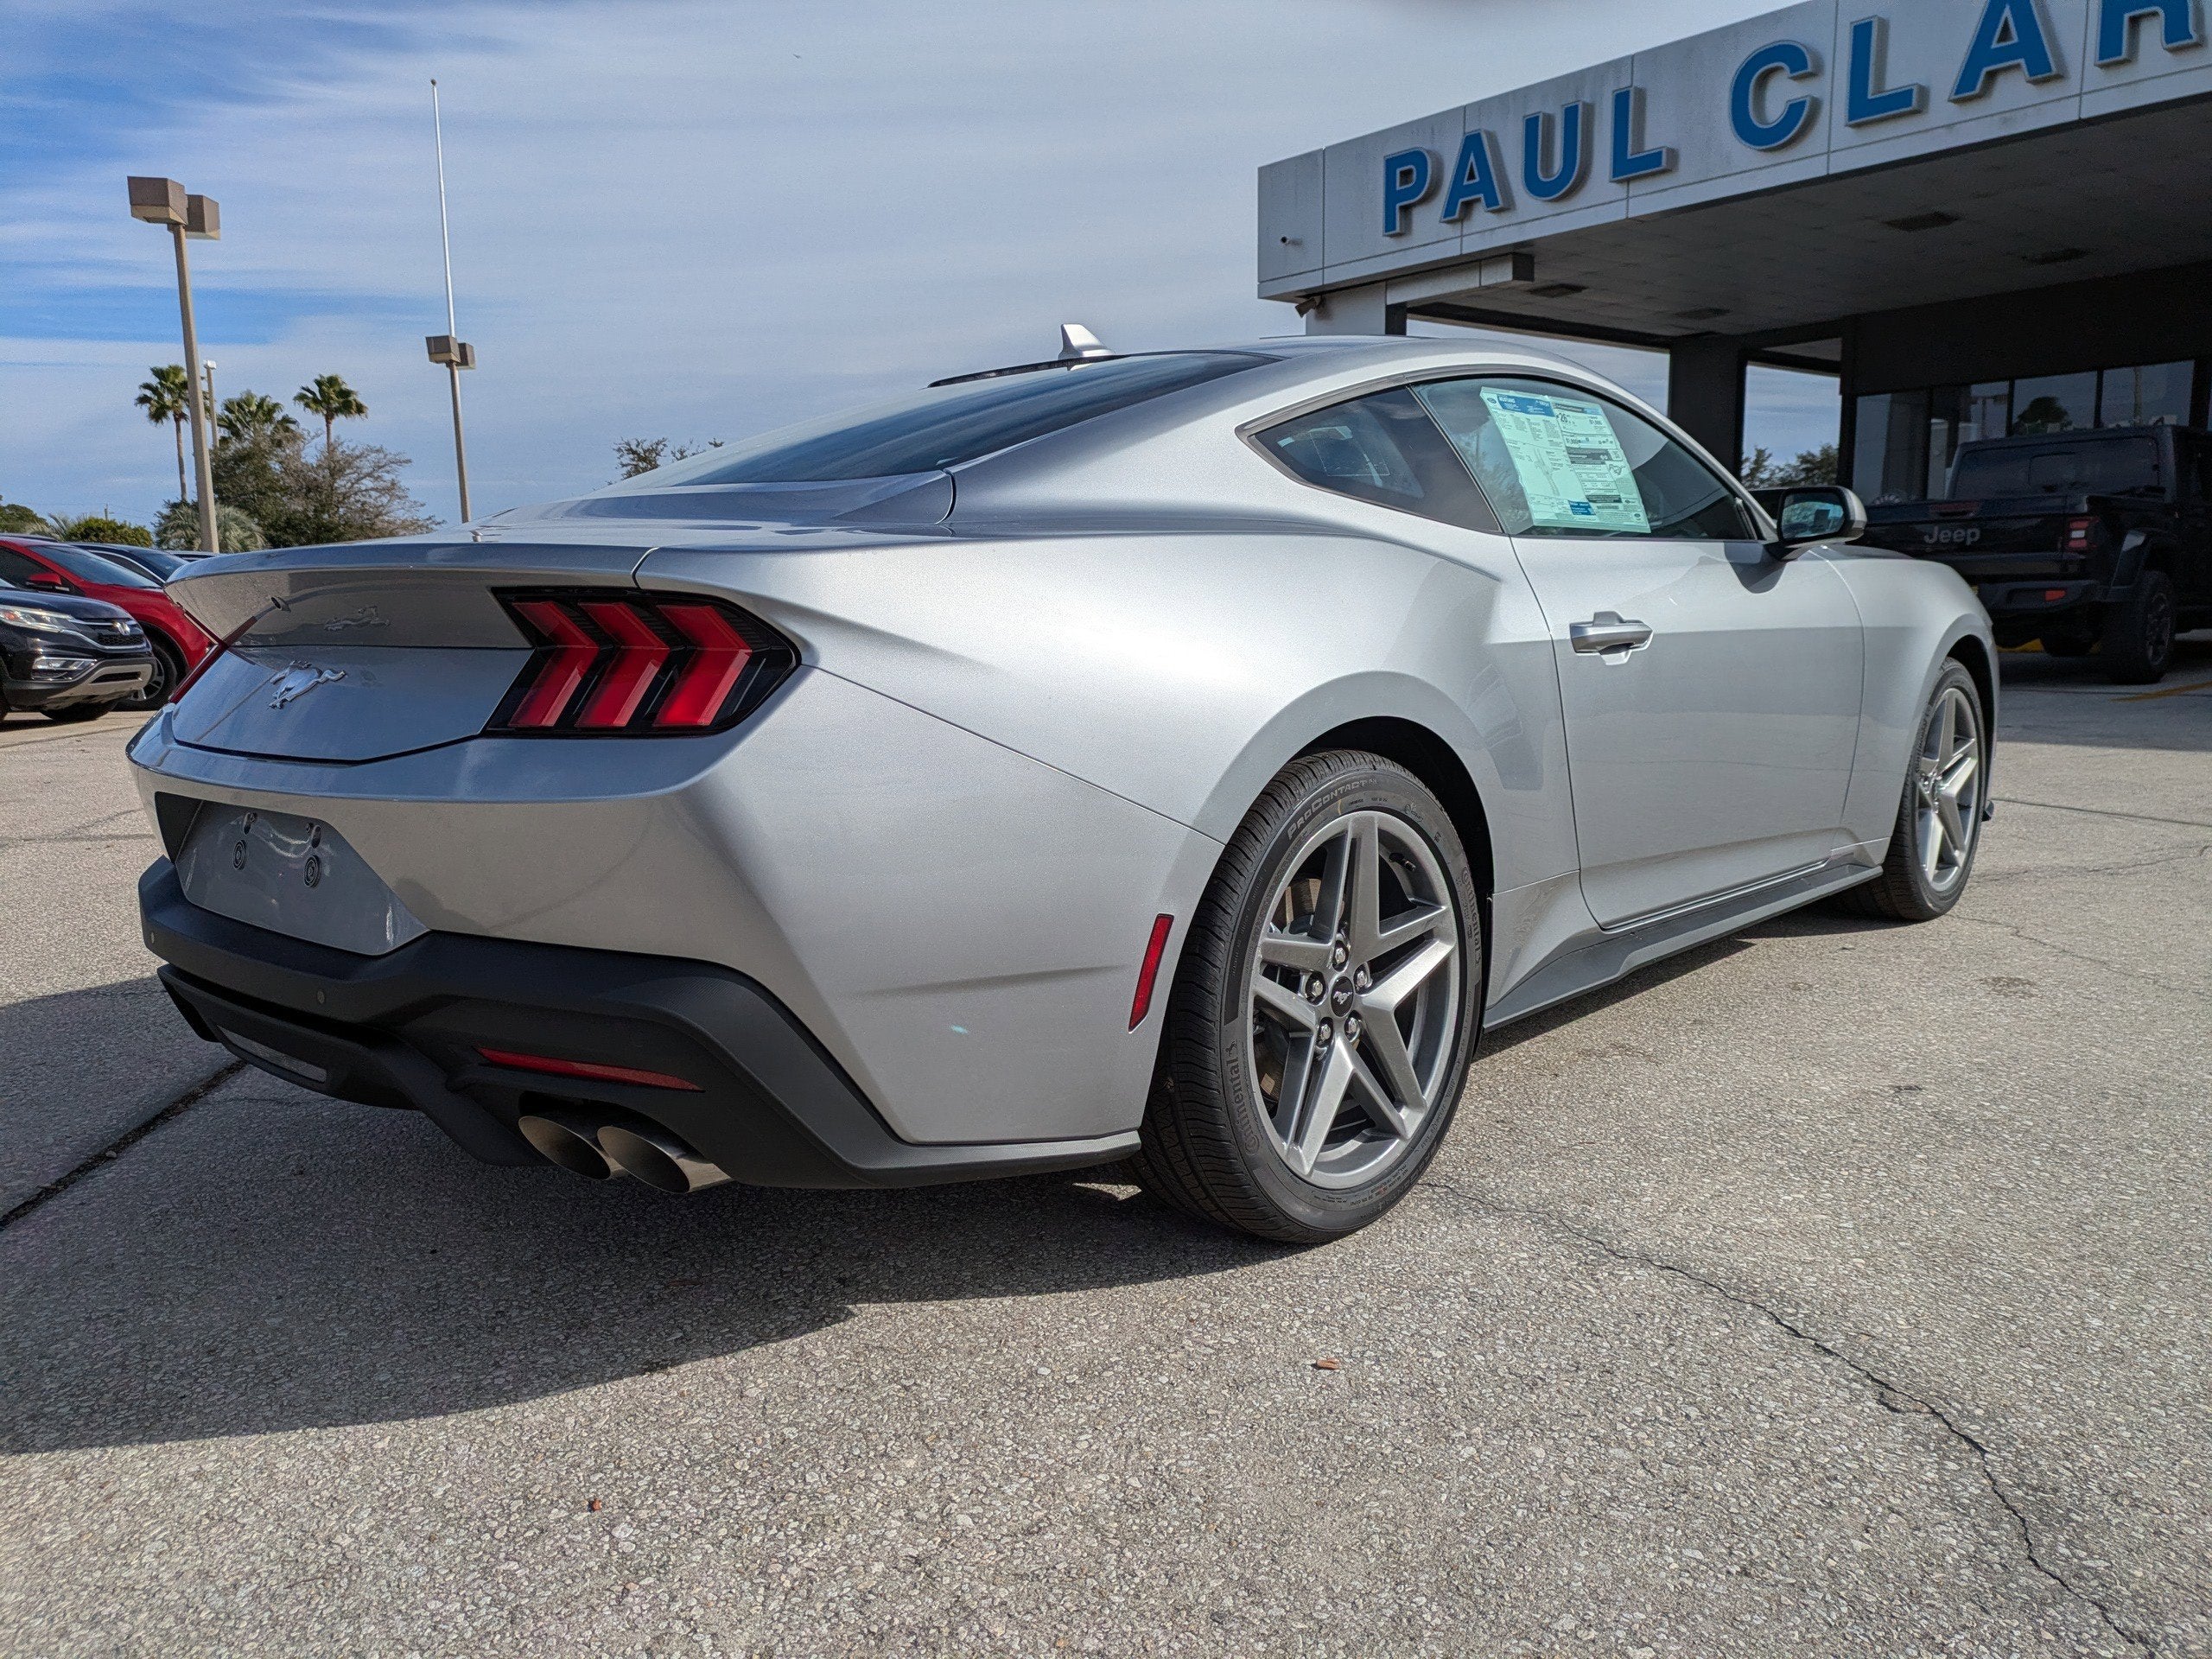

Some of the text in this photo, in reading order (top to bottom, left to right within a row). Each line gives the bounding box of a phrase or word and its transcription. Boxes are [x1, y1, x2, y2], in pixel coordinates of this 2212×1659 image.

[1382, 87, 1675, 236] PAUL
[1923, 525, 1980, 546] Jeep
[1225, 1056, 1260, 1155] Continental
